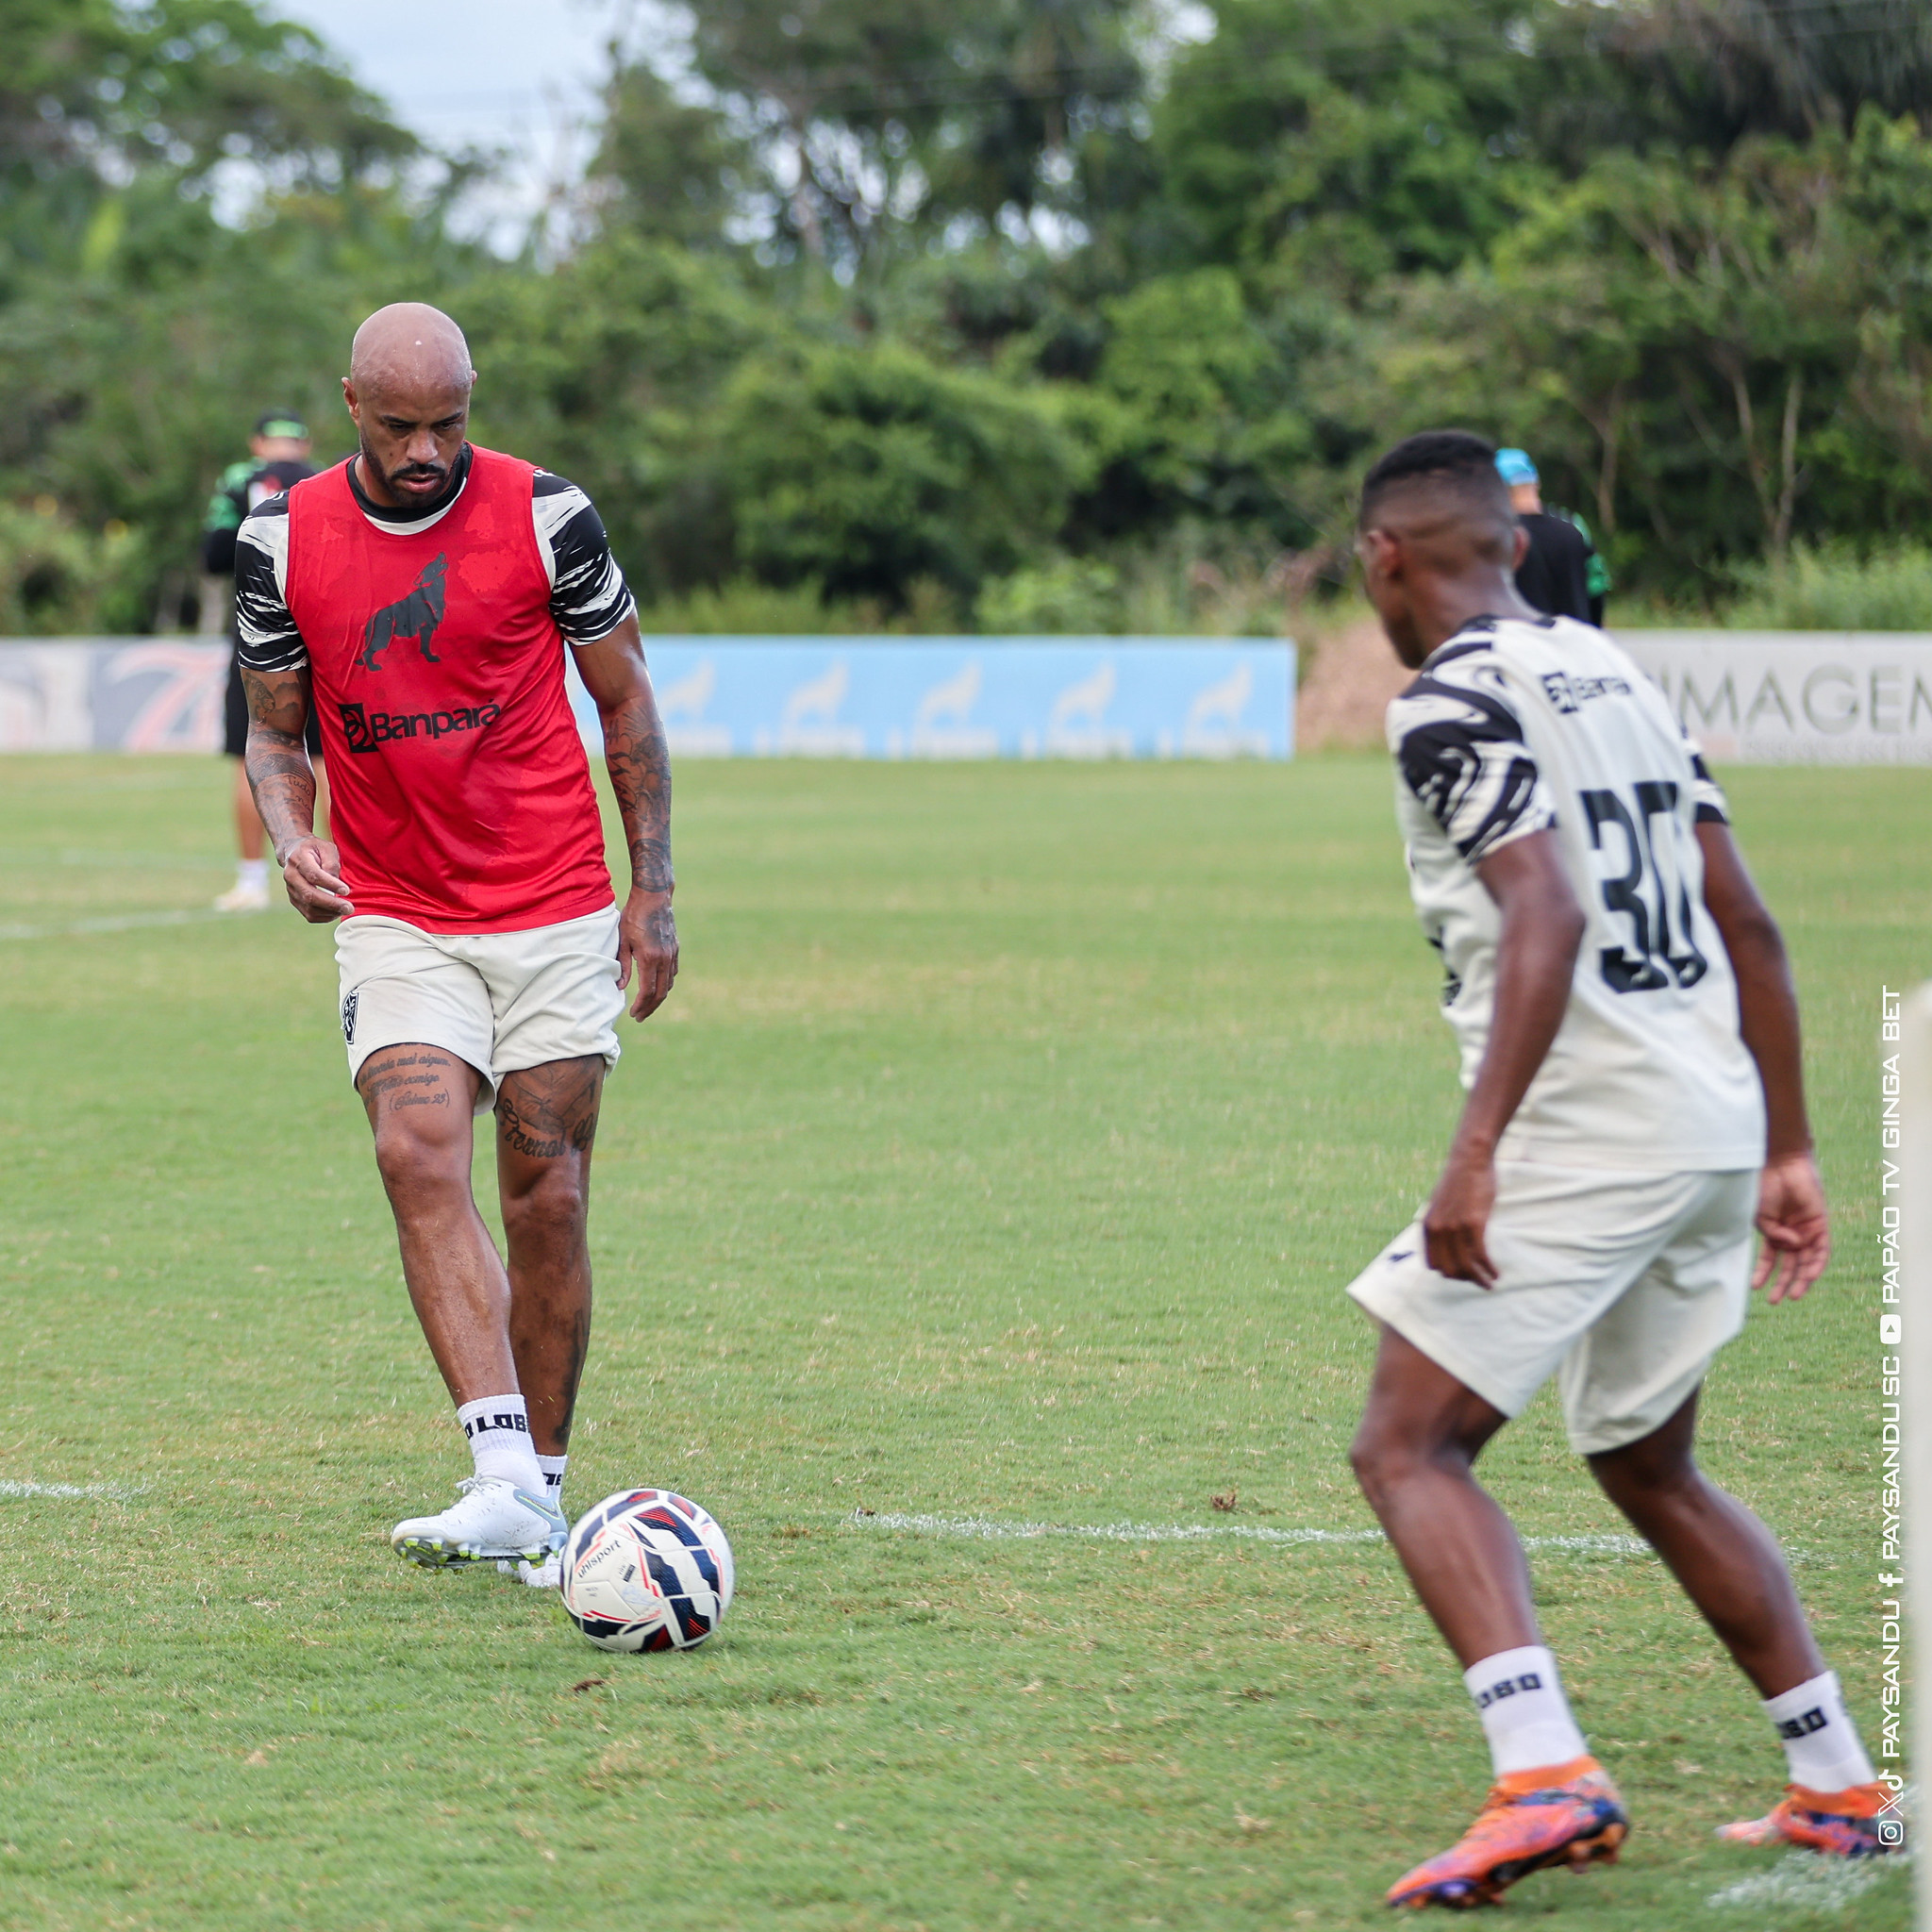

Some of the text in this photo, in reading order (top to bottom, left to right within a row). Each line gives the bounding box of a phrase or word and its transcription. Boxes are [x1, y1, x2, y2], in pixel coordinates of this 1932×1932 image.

[370, 699, 501, 742] Banpará
[1579, 781, 1708, 993] 30
[475, 1413, 530, 1434] LOB
[576, 1539, 622, 1579] uhlsport
